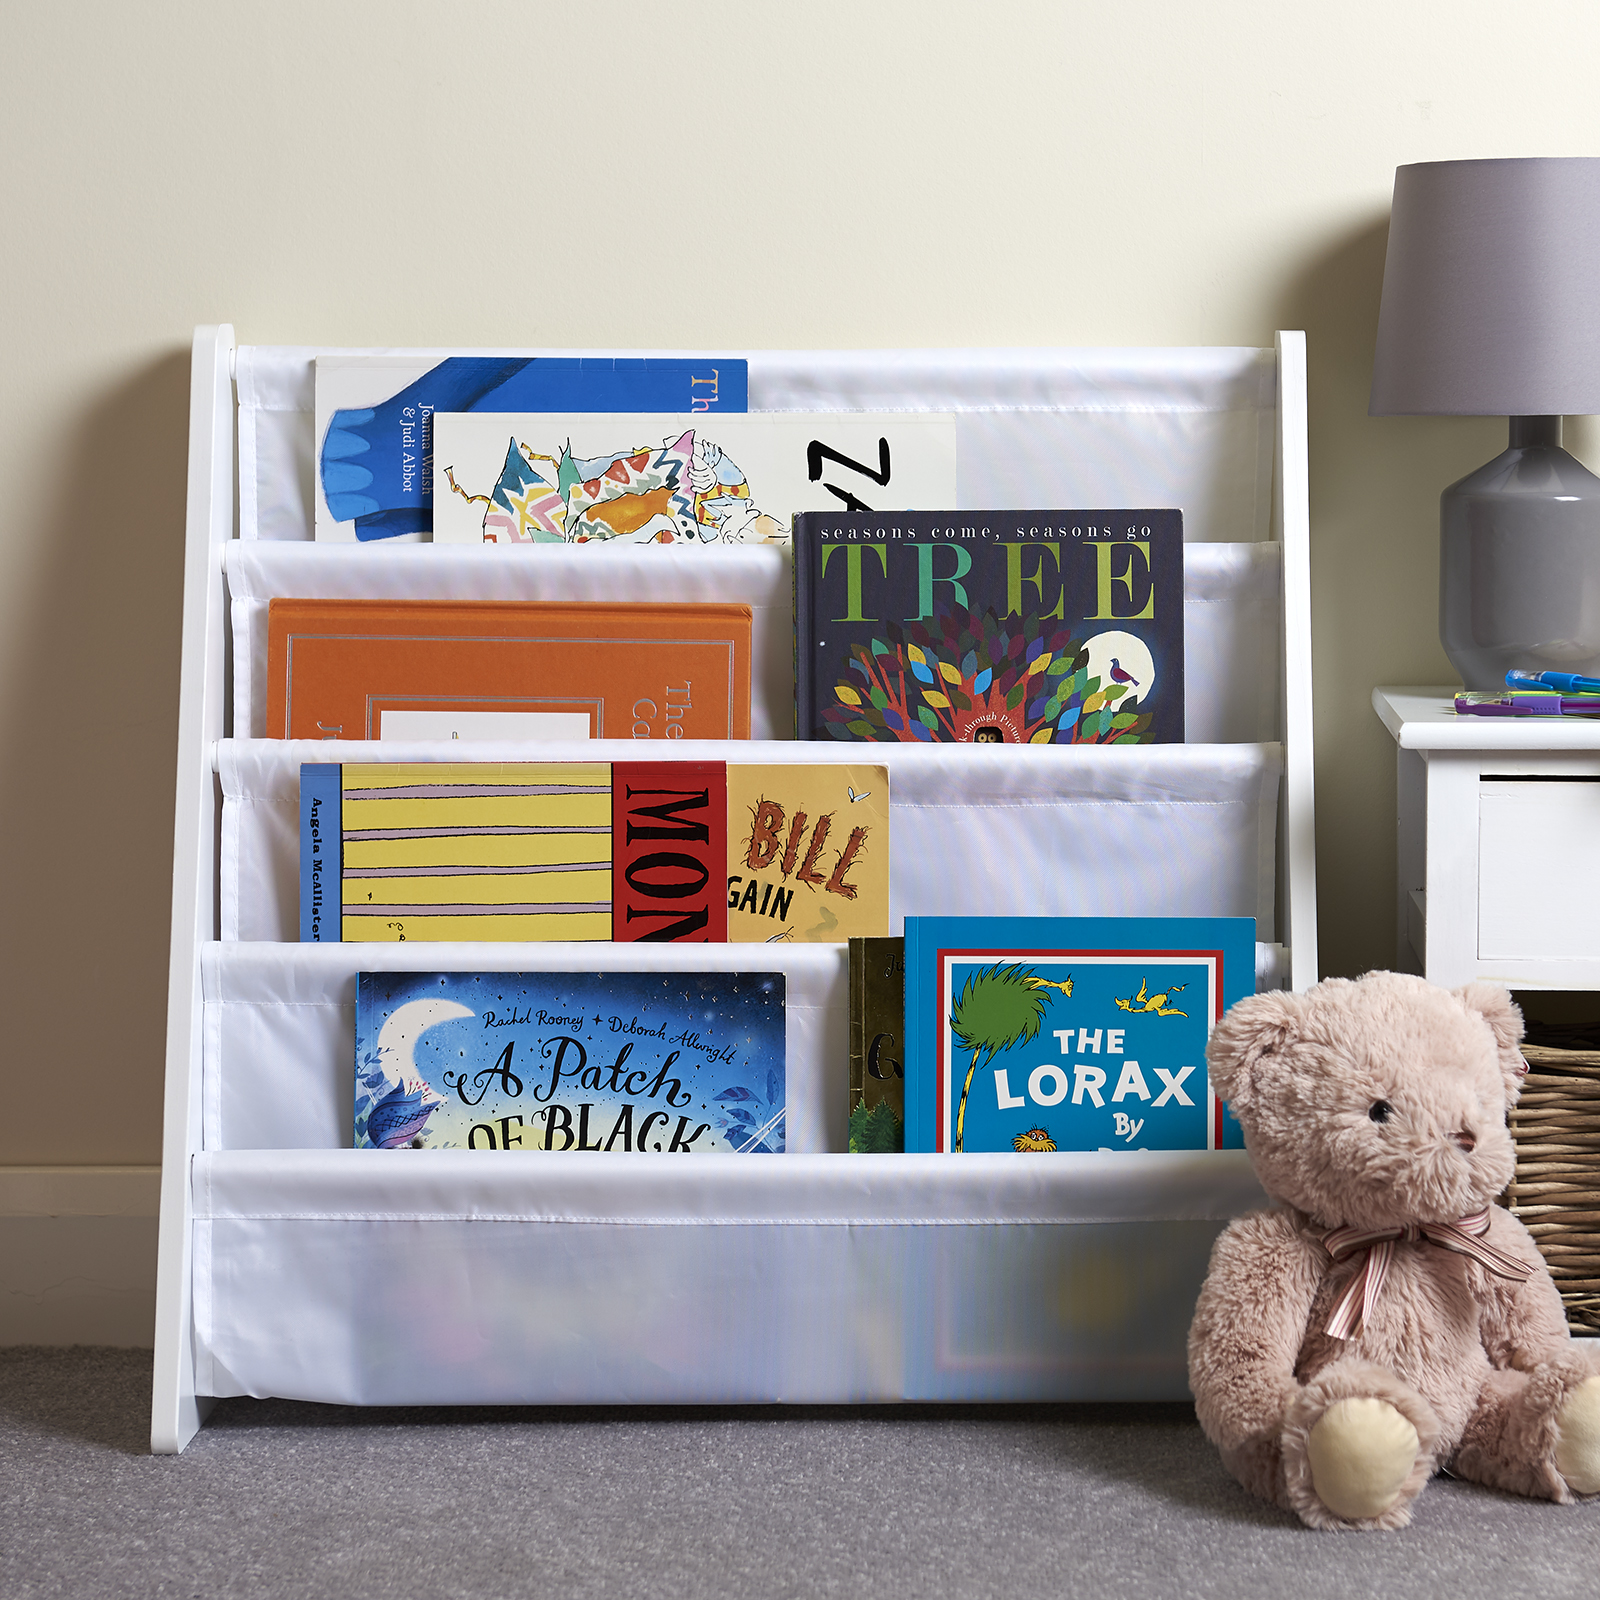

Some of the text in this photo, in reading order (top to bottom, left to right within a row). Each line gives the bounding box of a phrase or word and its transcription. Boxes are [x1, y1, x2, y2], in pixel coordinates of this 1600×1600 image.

[400, 407, 416, 492] & Judi Abbot
[418, 402, 434, 495] Joanna Walsh
[820, 525, 1152, 541] seasons come, seasons go
[821, 541, 1156, 622] TREE
[665, 680, 692, 739] The
[309, 797, 323, 942] Angela McAllister
[740, 793, 873, 900] BILL
[482, 1007, 738, 1065] Rachel Rooney Deborah Allwright
[1053, 1027, 1126, 1055] THE
[443, 1035, 692, 1108] A Patch
[993, 1060, 1197, 1110] LORAX
[468, 1103, 712, 1152] OF BLACK
[1112, 1112, 1145, 1143] By
